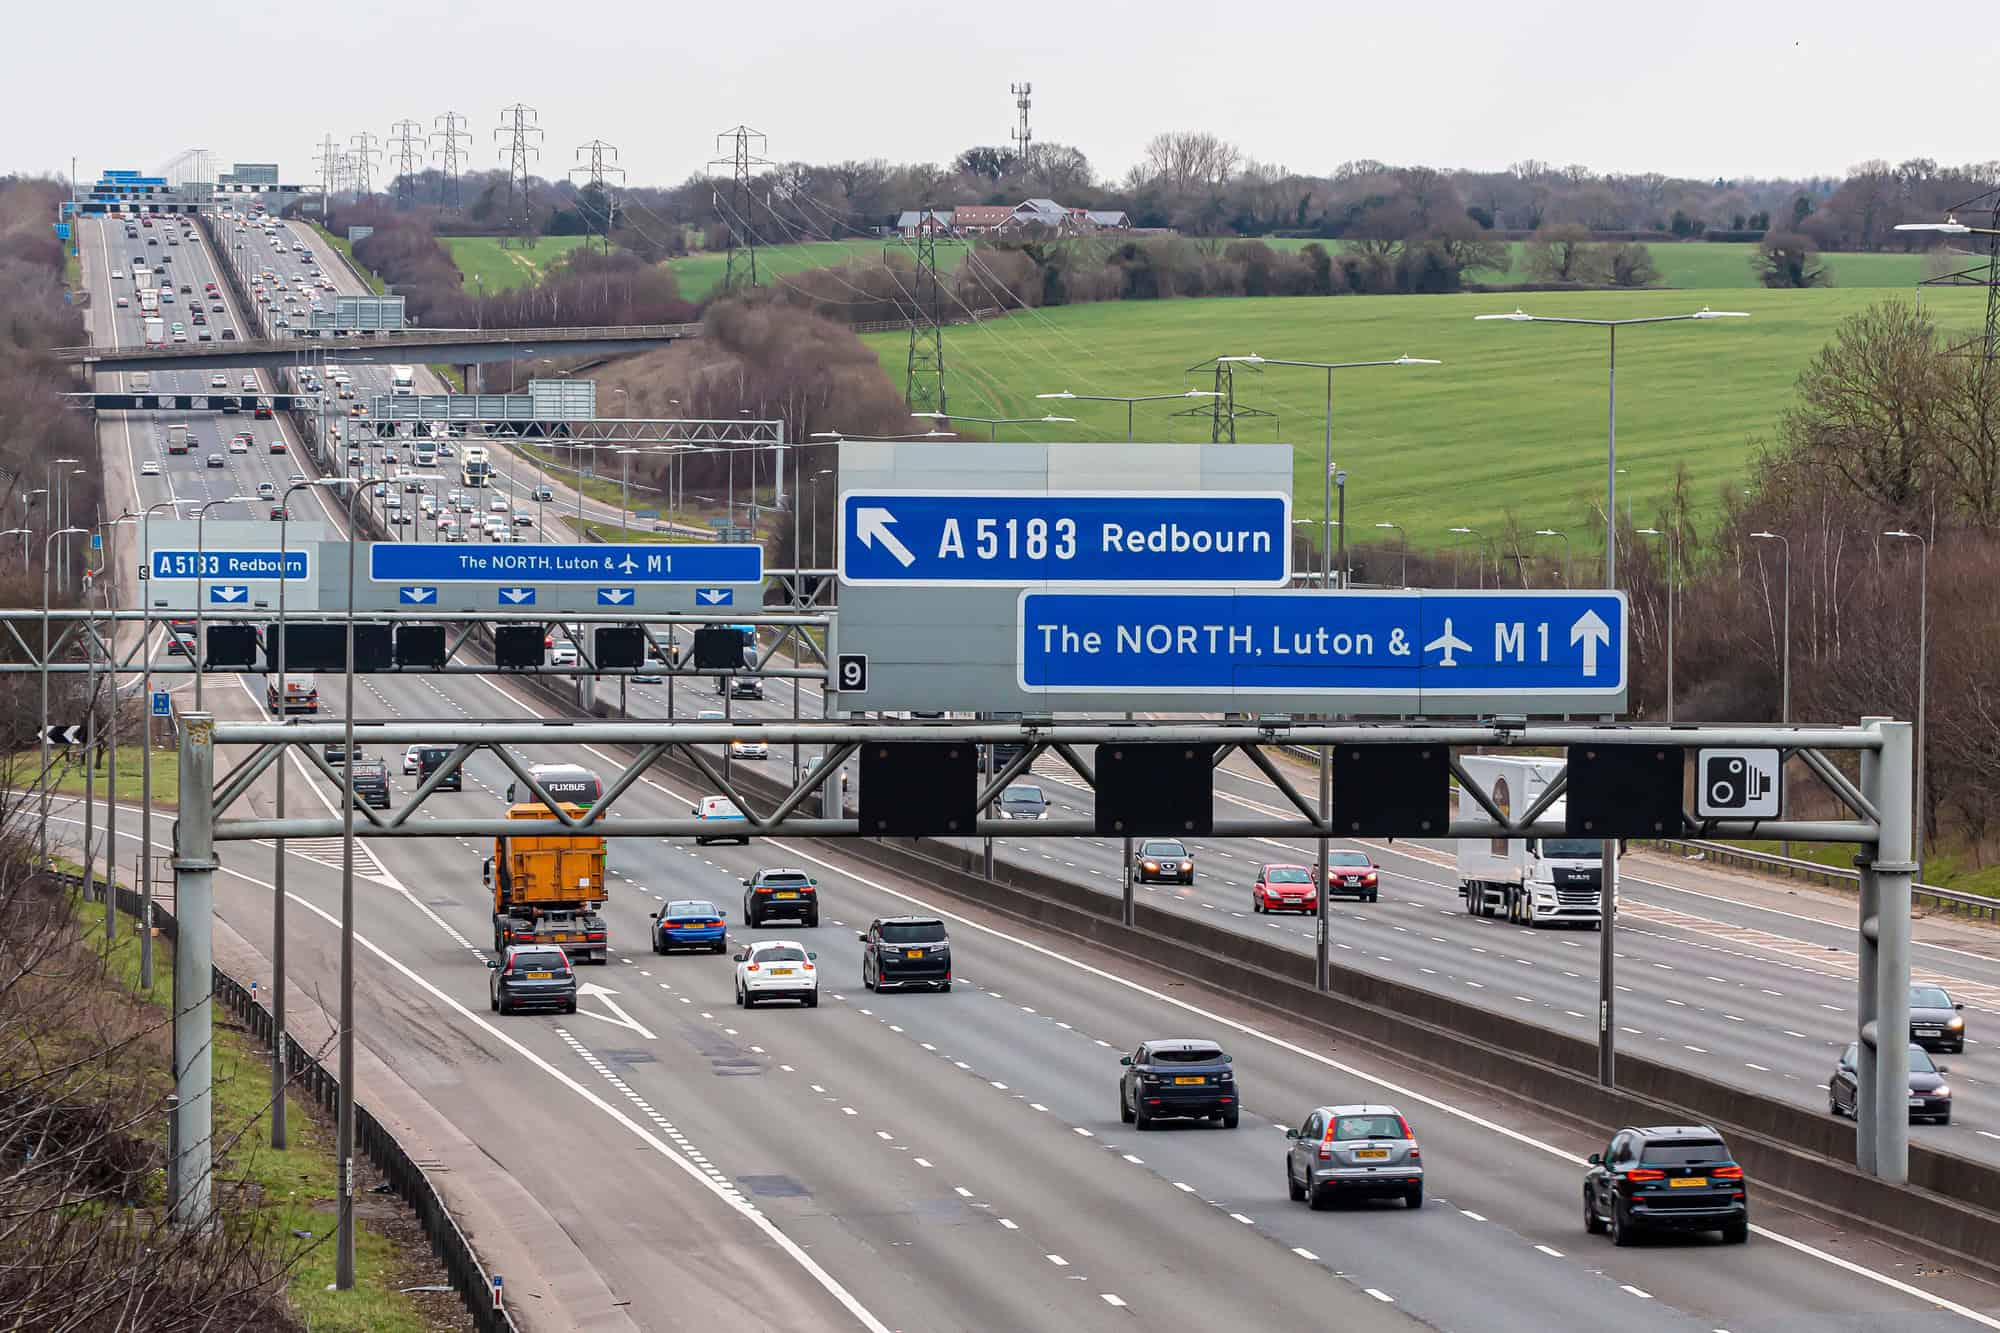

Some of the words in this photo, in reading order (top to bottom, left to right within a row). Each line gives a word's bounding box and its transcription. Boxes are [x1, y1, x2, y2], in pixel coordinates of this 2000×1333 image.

[937, 517, 1078, 560] A5183
[1102, 523, 1271, 553] Redbourn
[459, 555, 487, 569] The
[556, 556, 599, 569] Luton
[604, 556, 614, 570] &
[647, 554, 672, 573] M1
[1037, 624, 1102, 654] The
[1116, 624, 1262, 657] NORTH,
[1274, 625, 1373, 656] Luton
[1388, 627, 1411, 656] &
[1495, 622, 1549, 662] M1
[844, 662, 861, 687] 9
[549, 783, 586, 792] FLIXBUS
